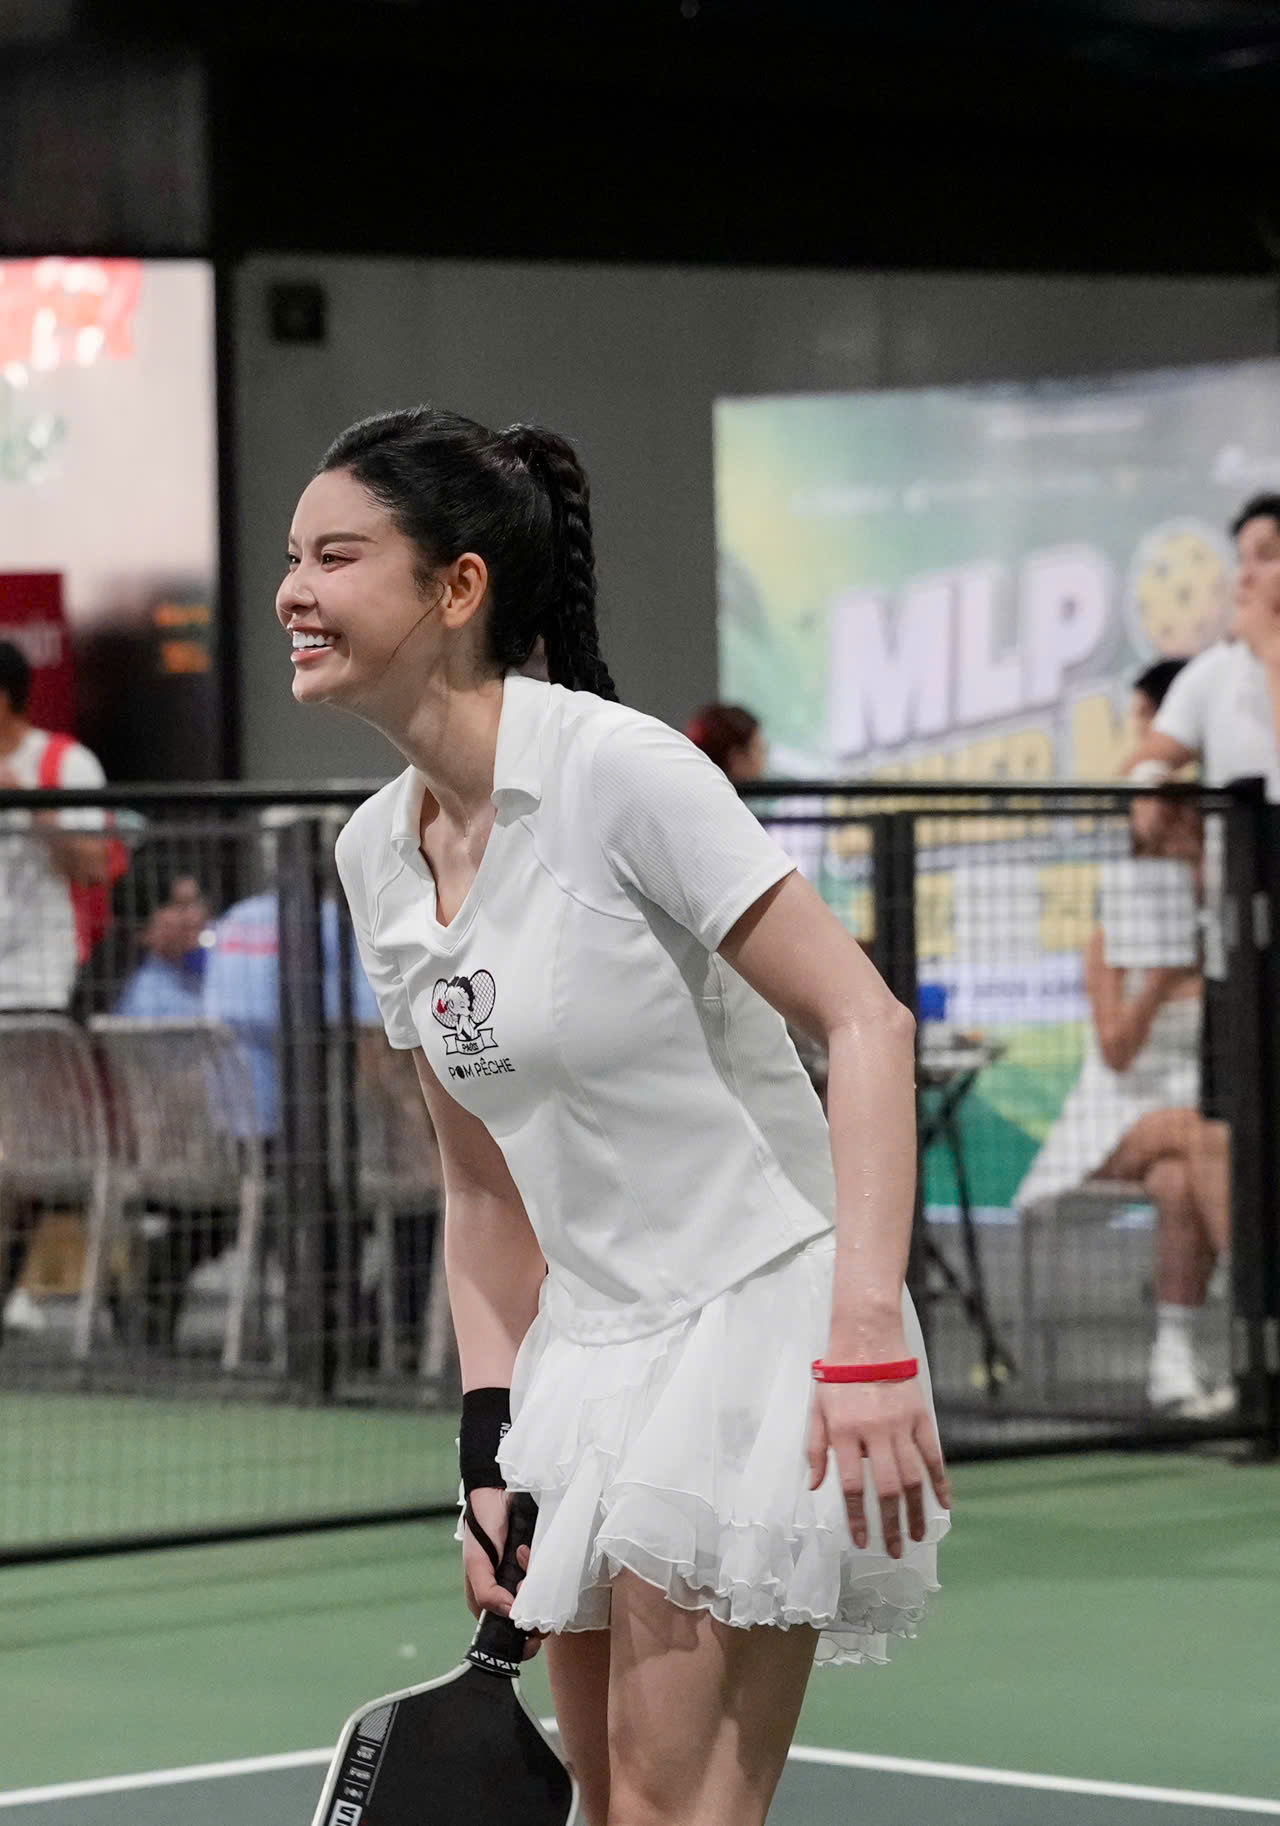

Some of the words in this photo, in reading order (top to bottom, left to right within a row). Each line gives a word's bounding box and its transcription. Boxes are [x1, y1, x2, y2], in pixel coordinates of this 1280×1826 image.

[828, 543, 1112, 758] MLP
[448, 1064, 475, 1080] POM
[474, 1057, 516, 1077] PÊCHE
